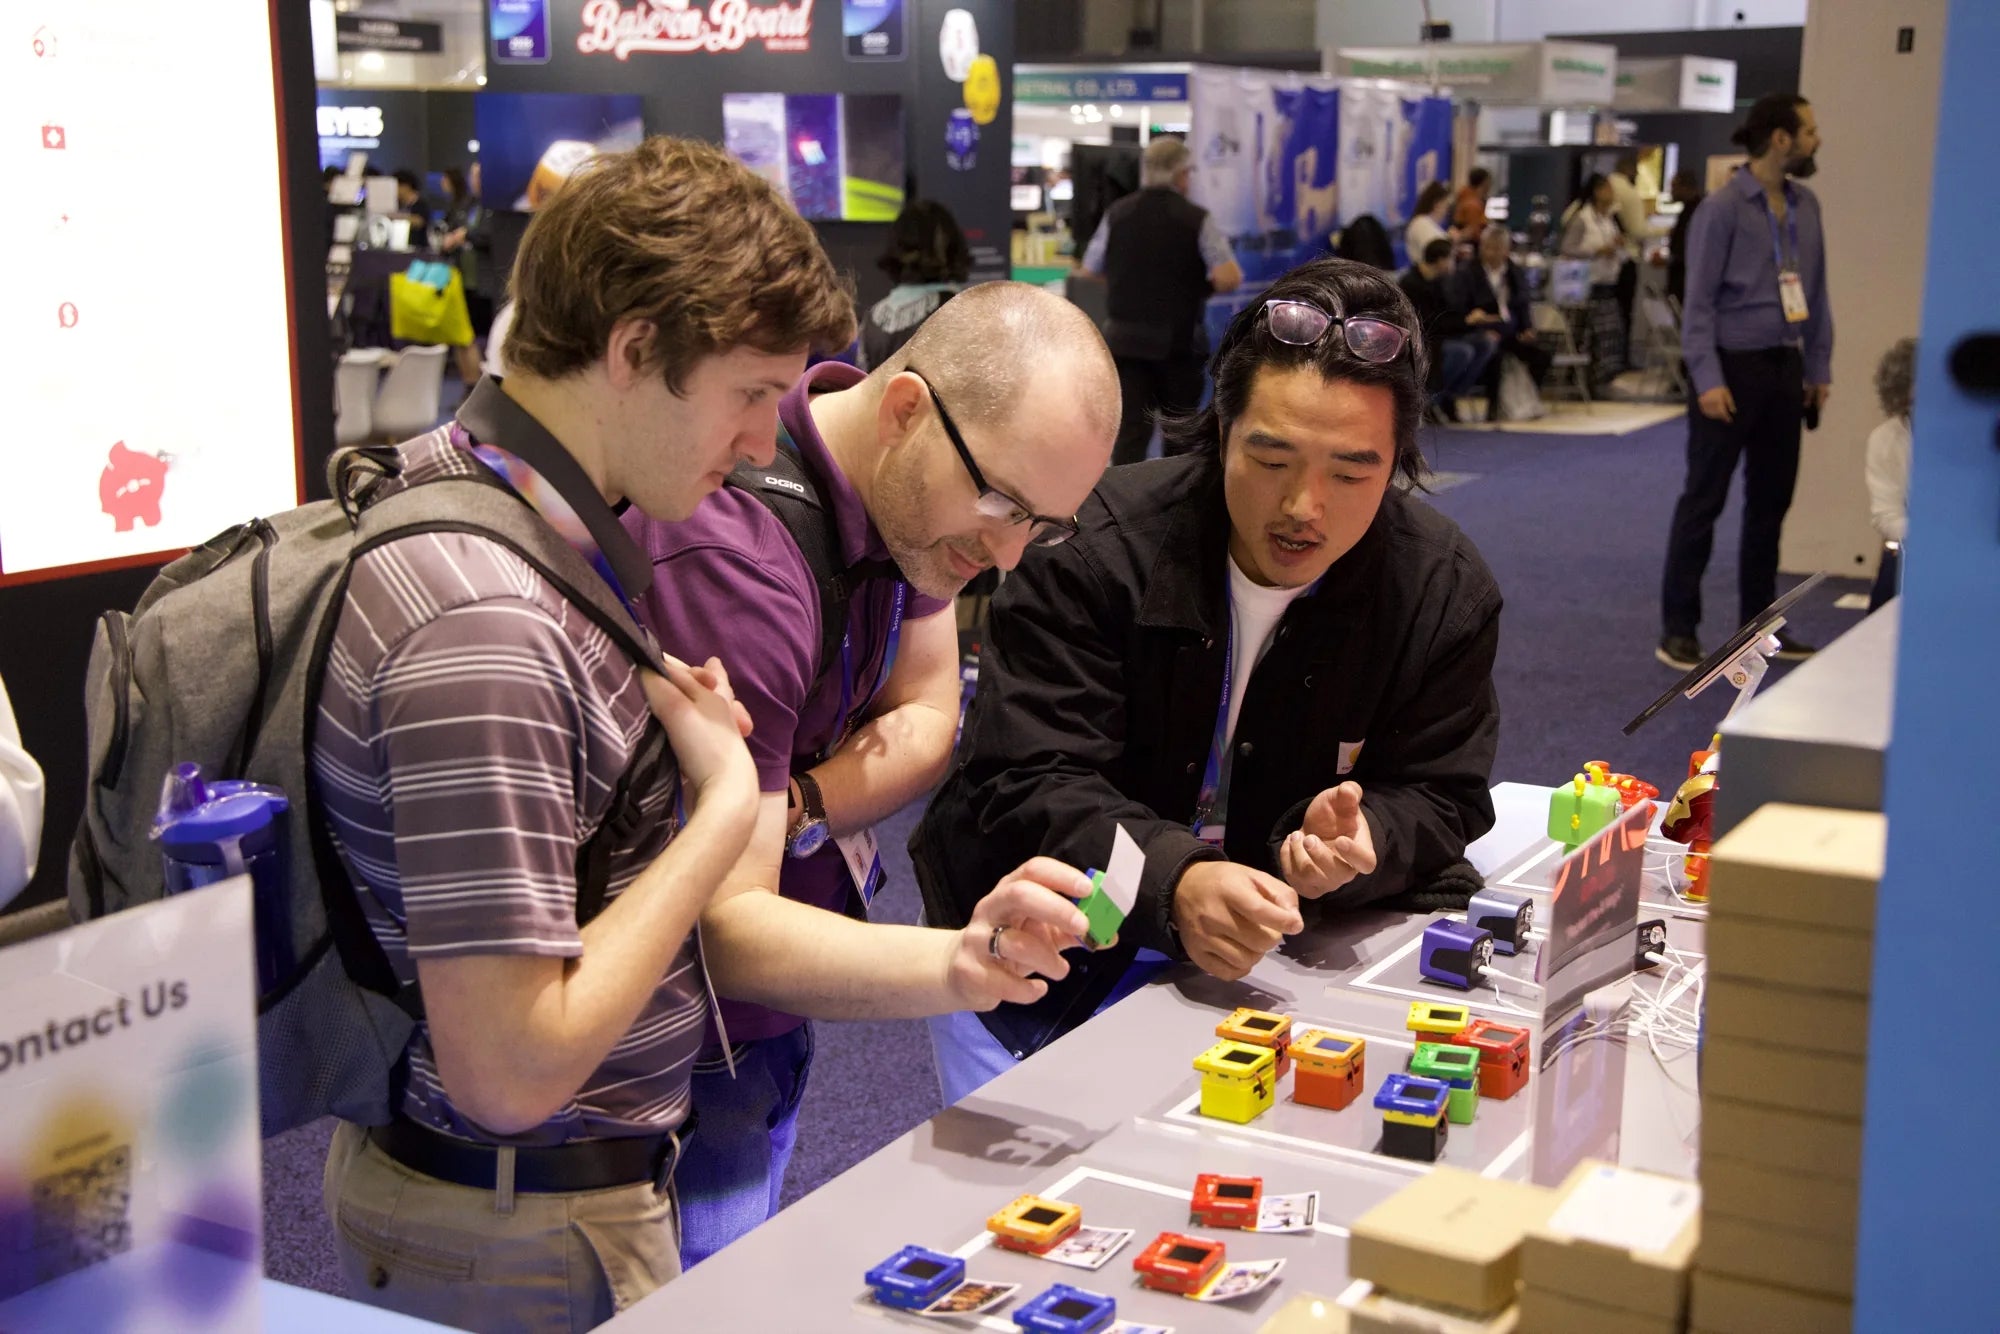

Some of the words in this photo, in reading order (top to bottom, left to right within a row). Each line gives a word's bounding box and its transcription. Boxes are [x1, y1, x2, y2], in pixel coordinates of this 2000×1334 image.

[765, 476, 804, 493] OGIO
[892, 607, 902, 632] Sony
[142, 979, 188, 1017] Us
